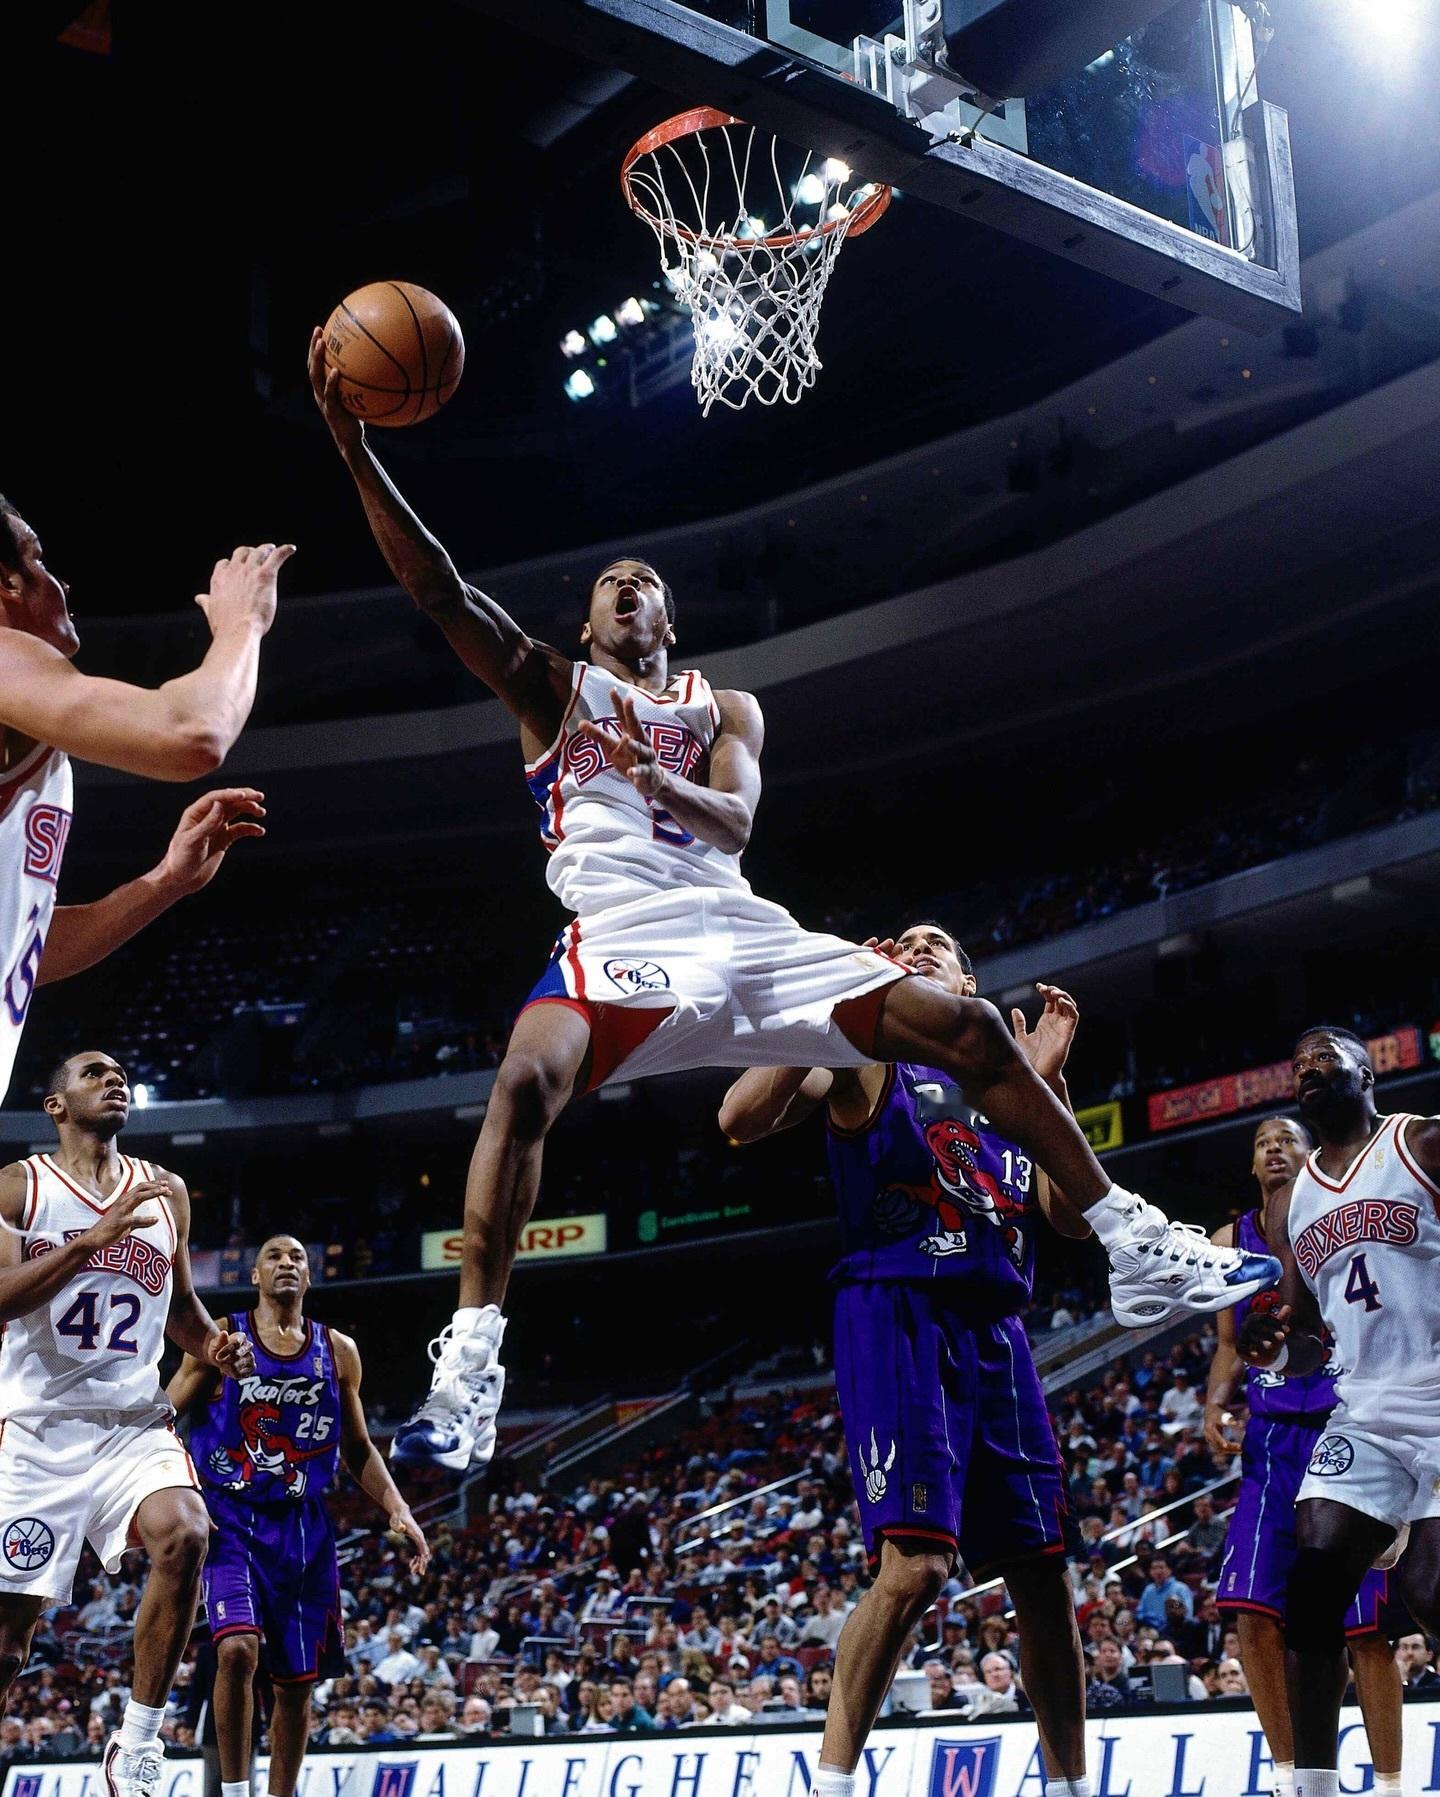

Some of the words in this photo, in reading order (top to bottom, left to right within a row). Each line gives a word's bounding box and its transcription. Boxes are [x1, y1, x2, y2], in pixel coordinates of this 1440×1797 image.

[565, 717, 703, 785] SER
[1001, 1149, 1033, 1193] 13
[28, 1229, 171, 1296] ERS
[442, 1224, 585, 1261] SRP
[1295, 1199, 1420, 1278] SIXERS
[1344, 1253, 1382, 1312] 4
[55, 1292, 141, 1354] 42
[295, 1412, 334, 1441] 25
[9, 1538, 49, 1558] 76ers
